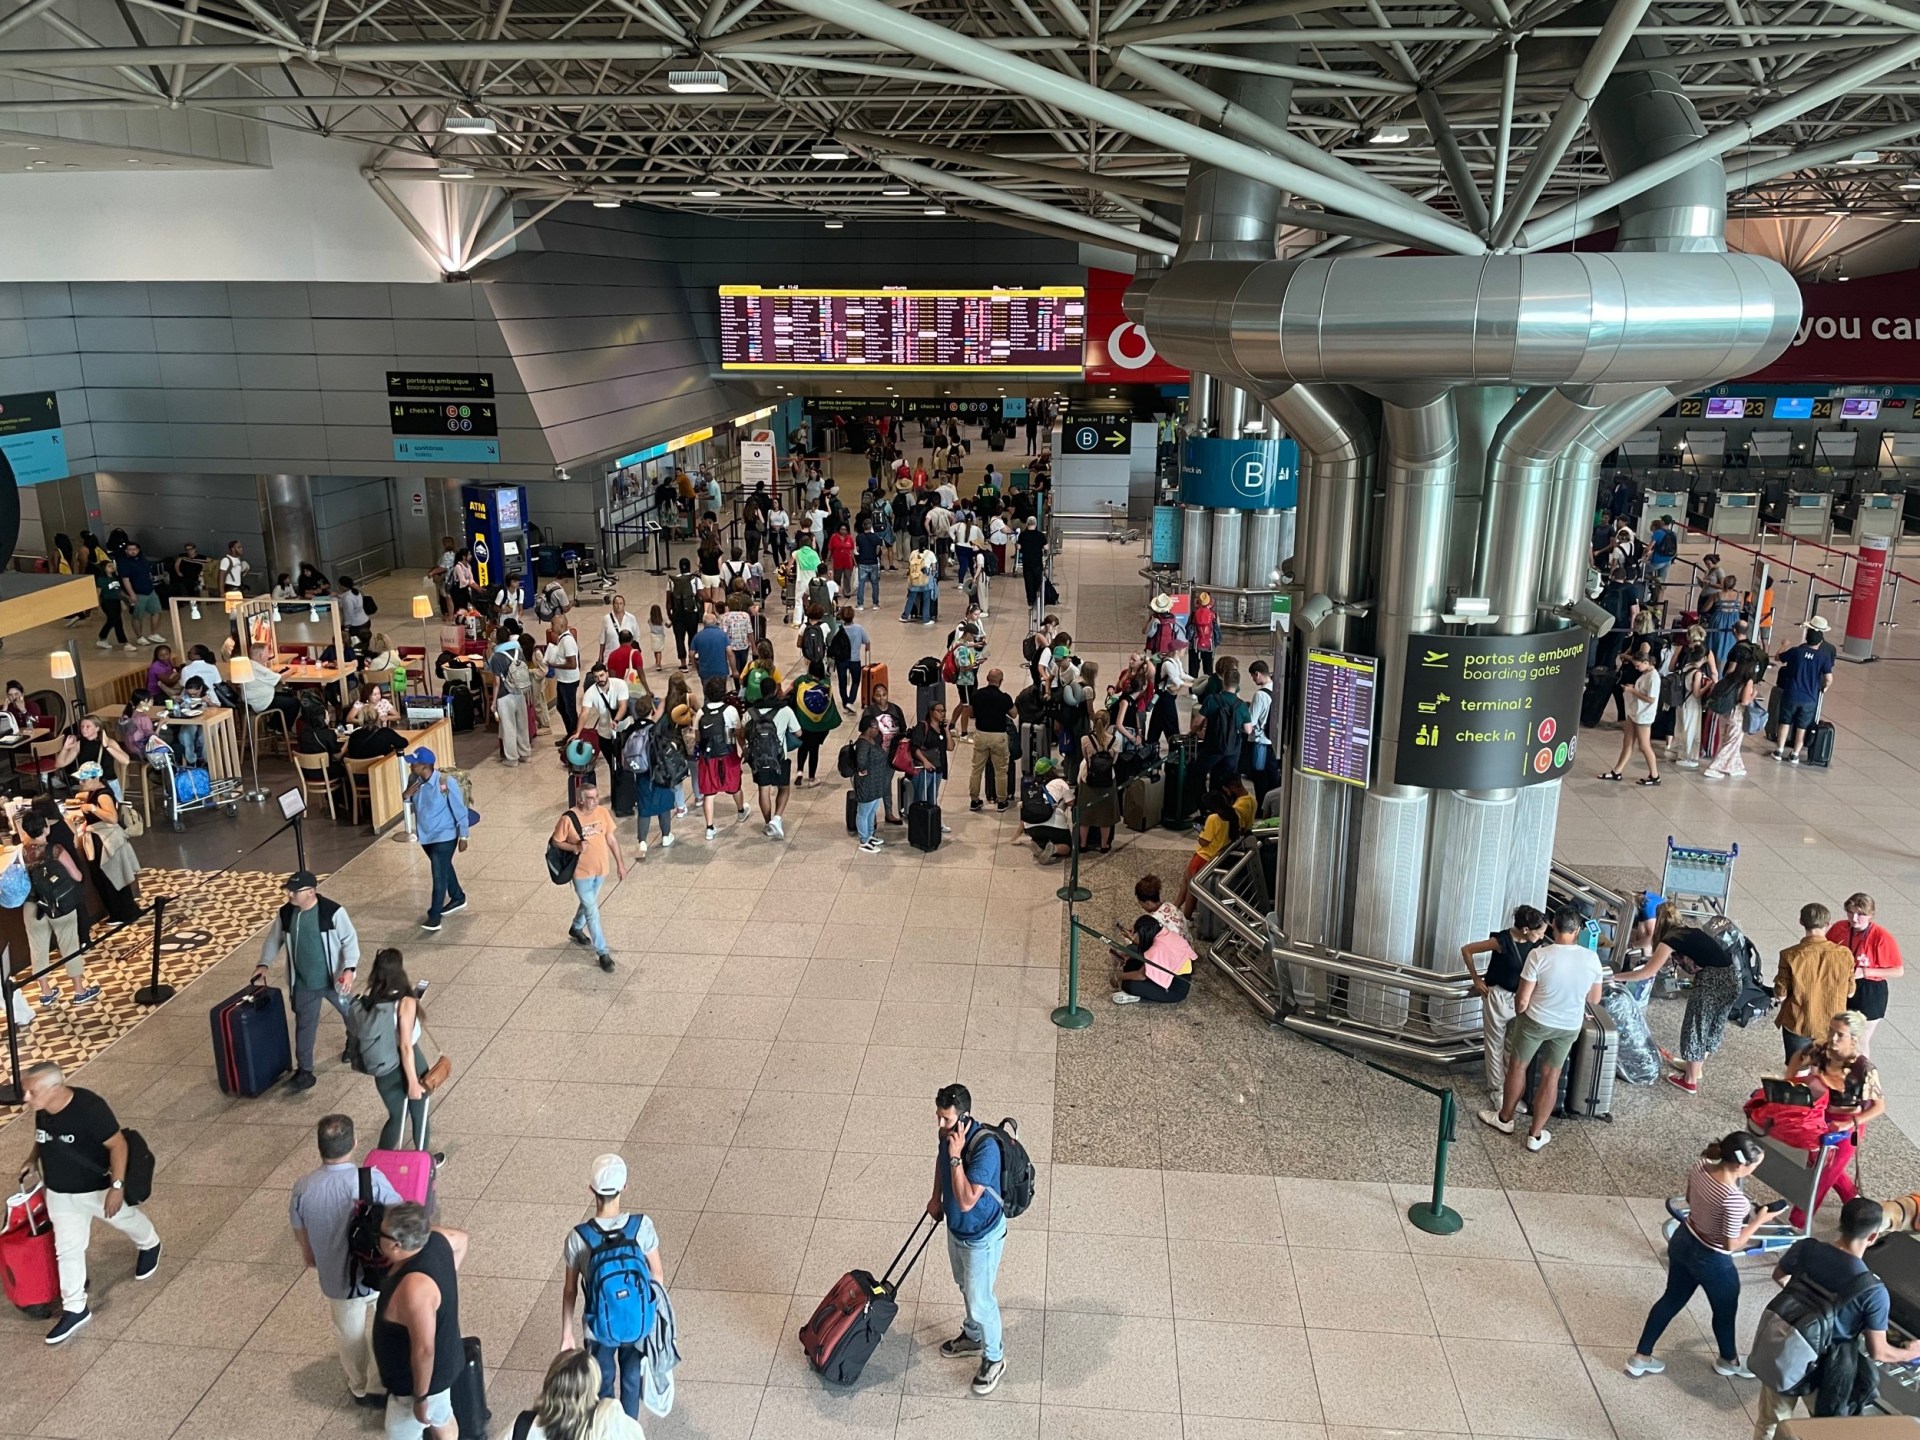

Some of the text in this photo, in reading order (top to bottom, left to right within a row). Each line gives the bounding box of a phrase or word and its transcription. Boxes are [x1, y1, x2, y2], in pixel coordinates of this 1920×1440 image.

[1793, 316, 1920, 346] you ca
[436, 379, 469, 387] embarque
[1681, 402, 1701, 415] 22
[1746, 402, 1764, 415] 23
[1813, 402, 1832, 416] 24
[1195, 466, 1202, 475] in
[1244, 461, 1264, 488] B
[470, 501, 486, 513] ATM
[1464, 643, 1584, 668] portas de embarque
[1463, 663, 1560, 682] boarding gates
[1460, 696, 1533, 711] terminal 2
[1455, 728, 1500, 742] check
[1503, 729, 1516, 741] in
